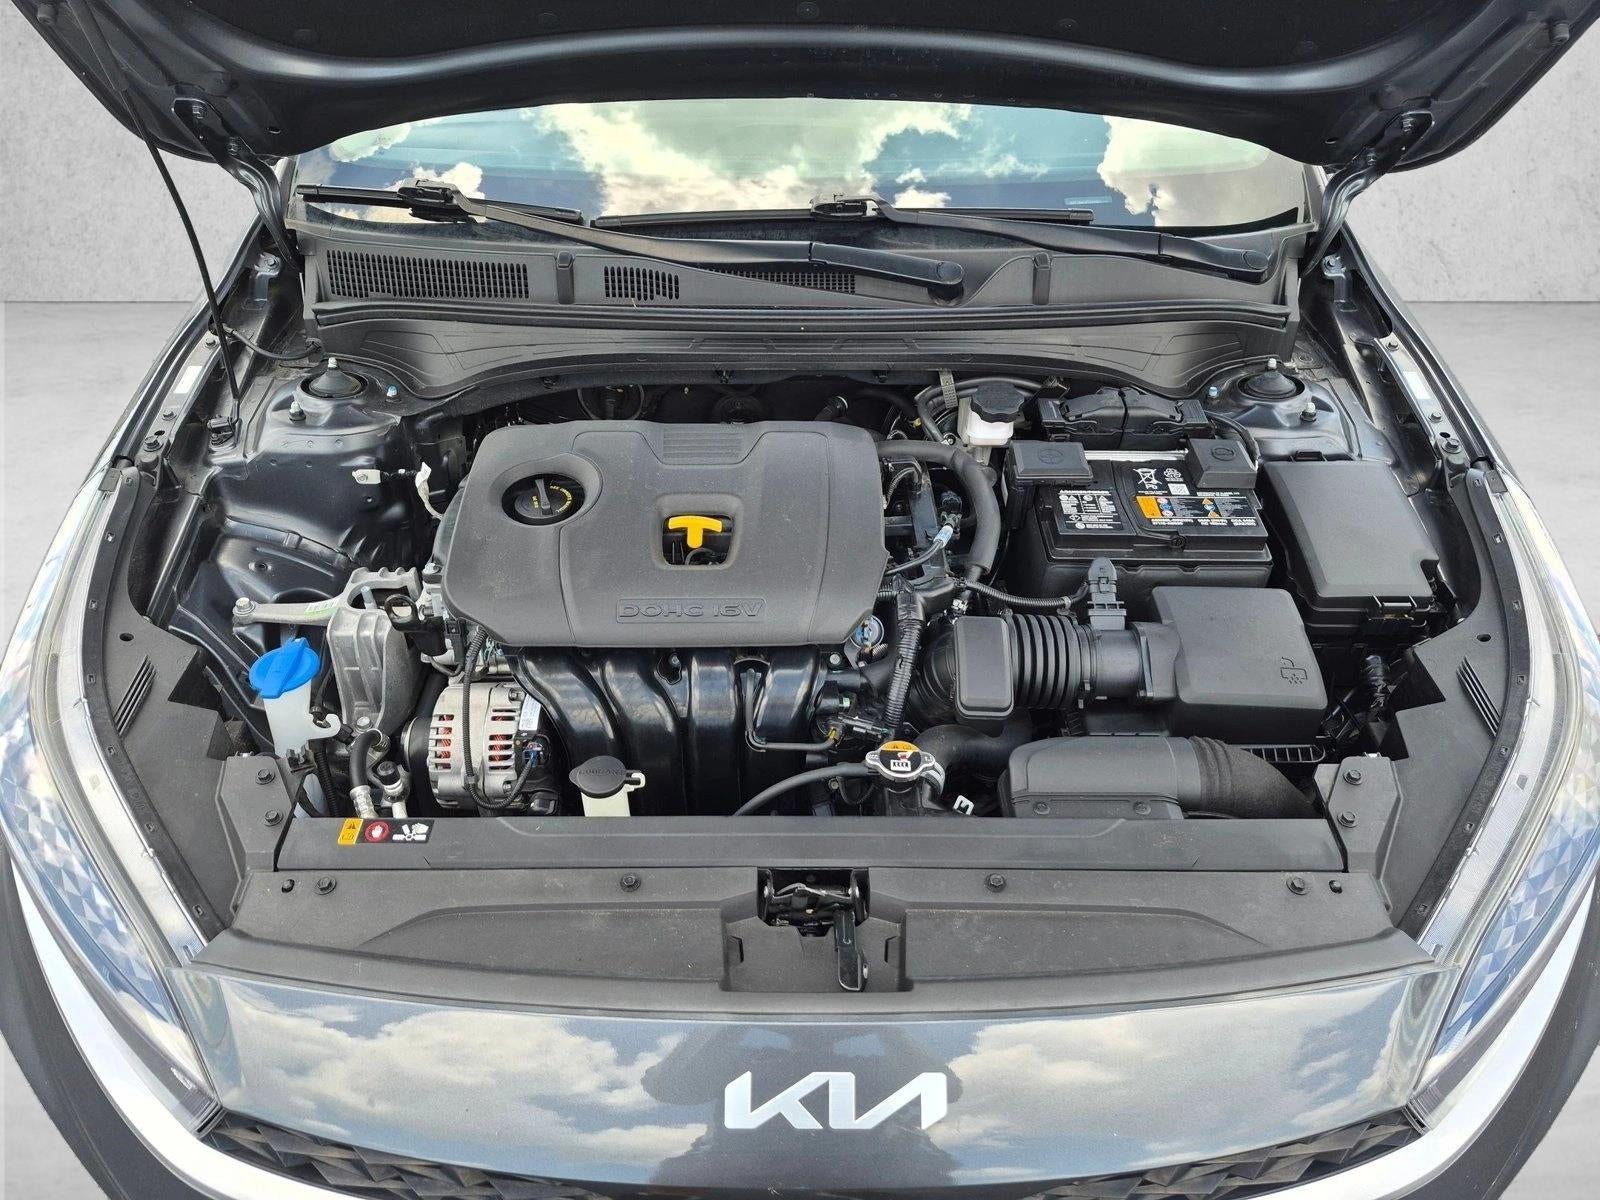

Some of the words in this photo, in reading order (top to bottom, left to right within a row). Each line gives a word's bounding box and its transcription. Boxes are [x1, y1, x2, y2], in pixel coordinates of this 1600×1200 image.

[618, 602, 705, 618] DOHC
[712, 602, 764, 618] 16V
[724, 1070, 948, 1130] KIA
